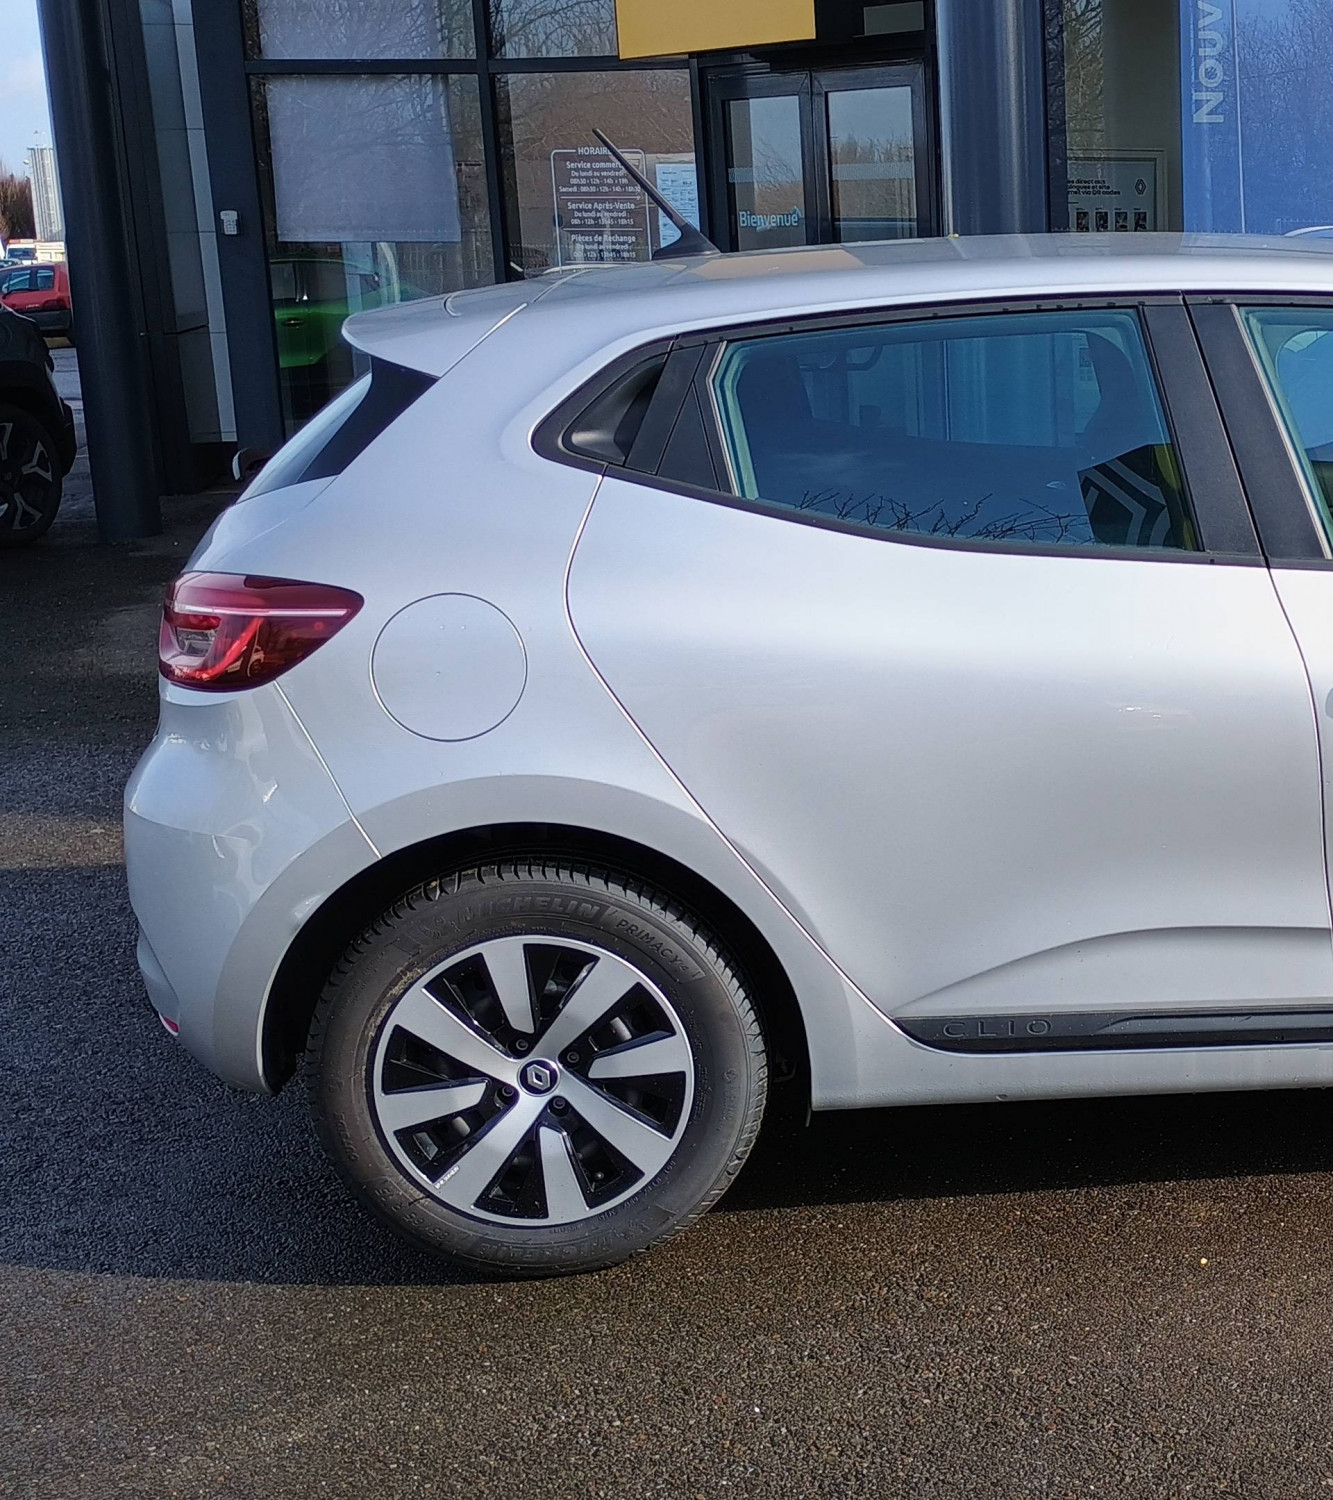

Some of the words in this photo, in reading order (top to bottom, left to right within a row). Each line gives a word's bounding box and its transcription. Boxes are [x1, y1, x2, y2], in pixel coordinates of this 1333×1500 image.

[578, 147, 611, 155] HORAIRE
[739, 211, 798, 227] Bienvenue
[572, 234, 592, 242] Pièces
[603, 235, 635, 243] Rechange
[457, 898, 600, 923] MICHELIN
[616, 919, 681, 967] PRIMACY
[943, 1020, 1052, 1037] CLIO
